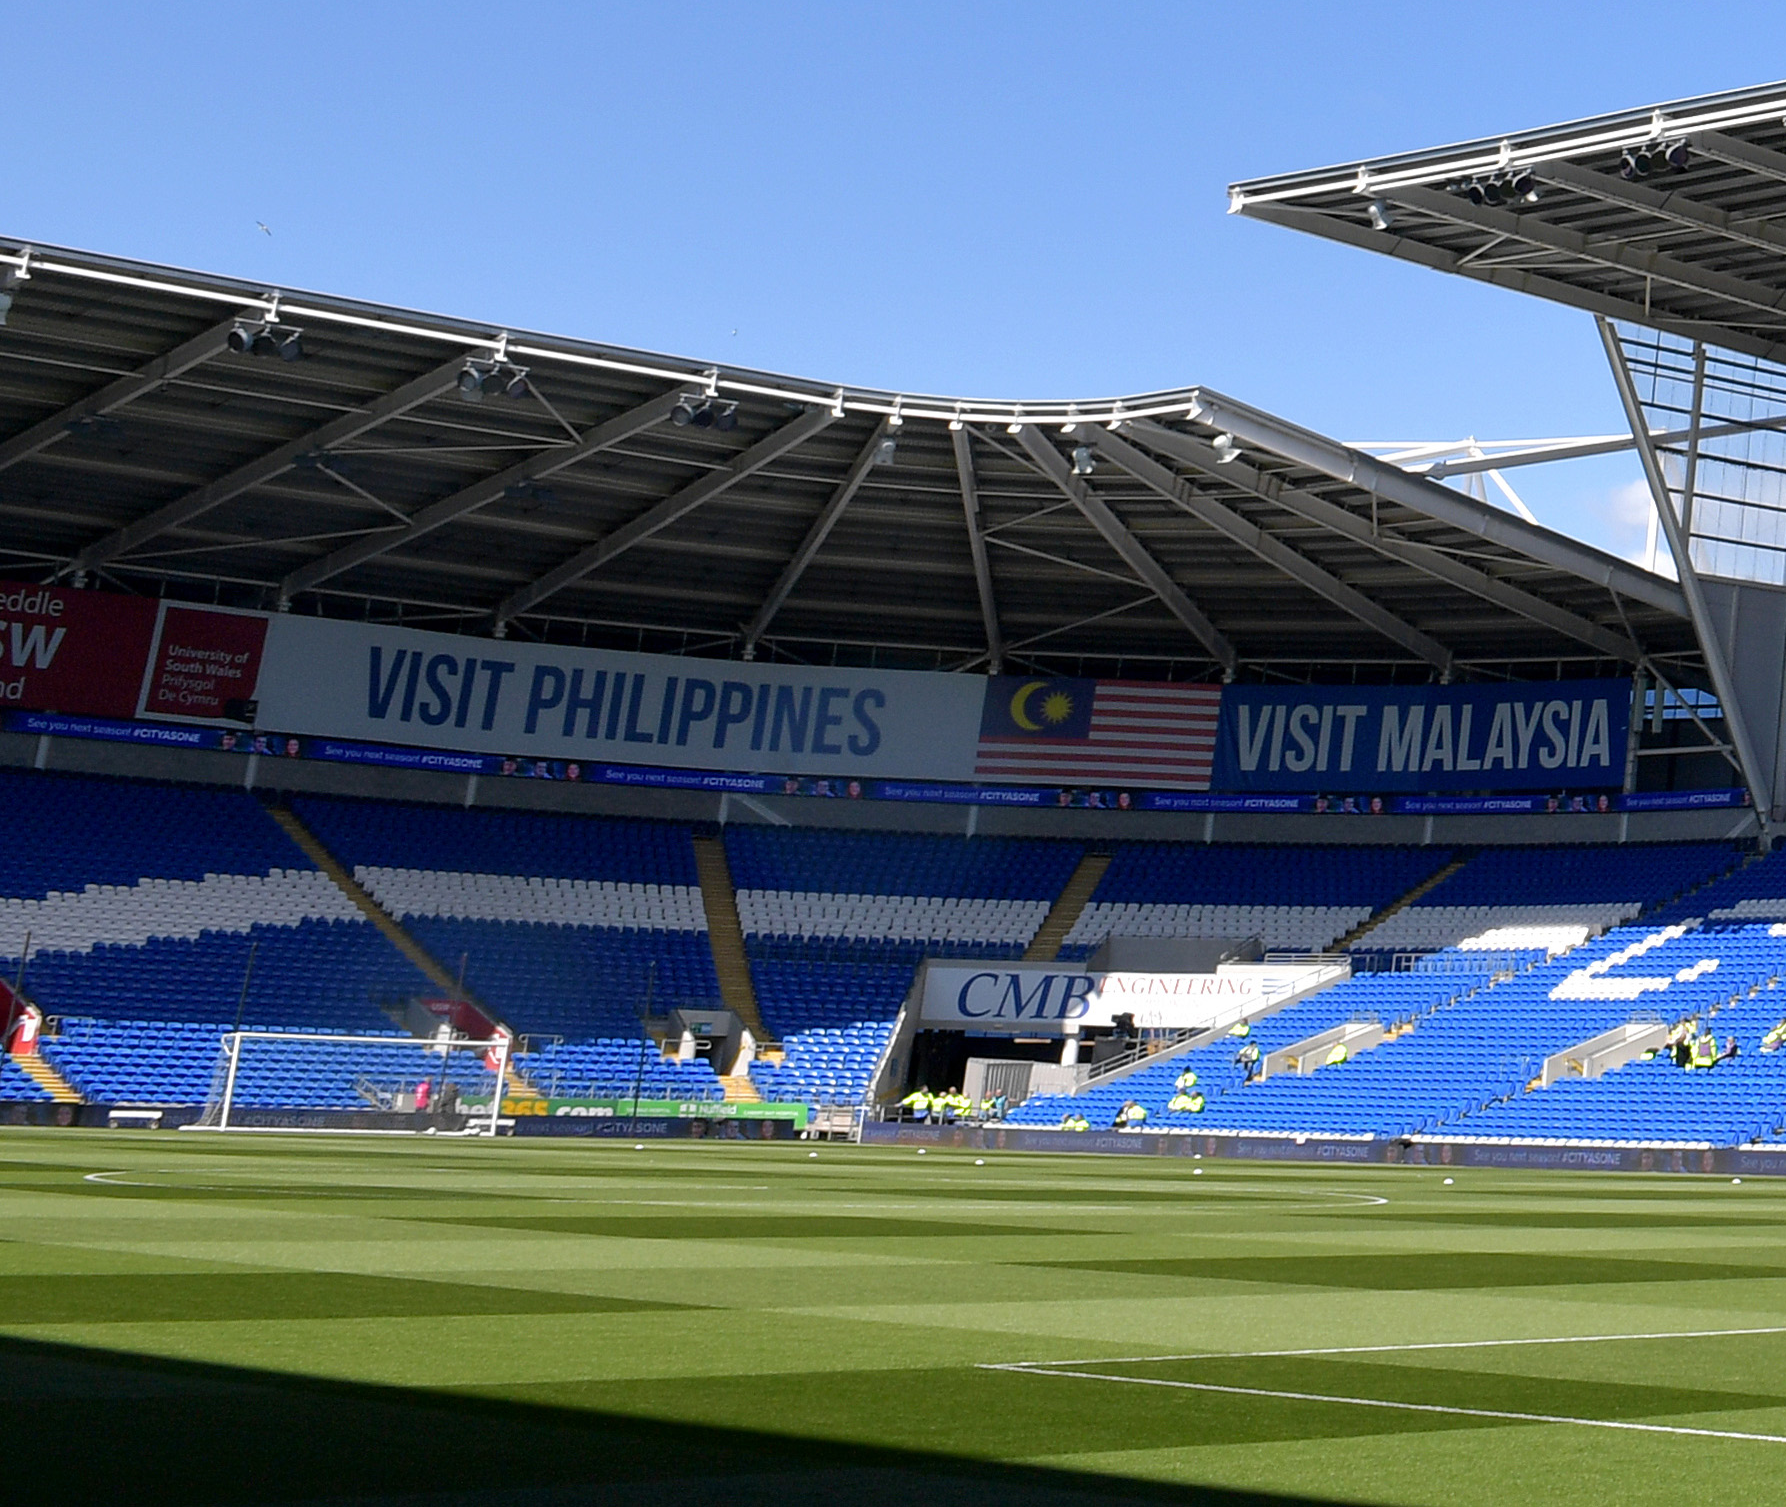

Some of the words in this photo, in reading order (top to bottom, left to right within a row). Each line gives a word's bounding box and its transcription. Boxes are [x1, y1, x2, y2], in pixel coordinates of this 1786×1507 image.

[169, 645, 231, 663] University
[235, 653, 249, 664] of
[165, 659, 202, 673] South
[206, 664, 242, 678] Wales
[162, 674, 214, 691] Prifysgol
[159, 690, 175, 700] De
[179, 693, 219, 706] Cymru
[366, 646, 515, 731] VISIT
[524, 664, 886, 757] PHILIPPINES
[133, 728, 201, 743] #CITYASONE
[1238, 705, 1367, 772] VISIT
[1377, 699, 1611, 772] MALAYSIA
[422, 755, 482, 769] #CITYASONE
[703, 776, 765, 789] #CITYASONE
[957, 972, 1096, 1020] CMB
[1099, 976, 1252, 995] ENGINEERING
[1562, 1152, 1620, 1165] #CITYASONE
